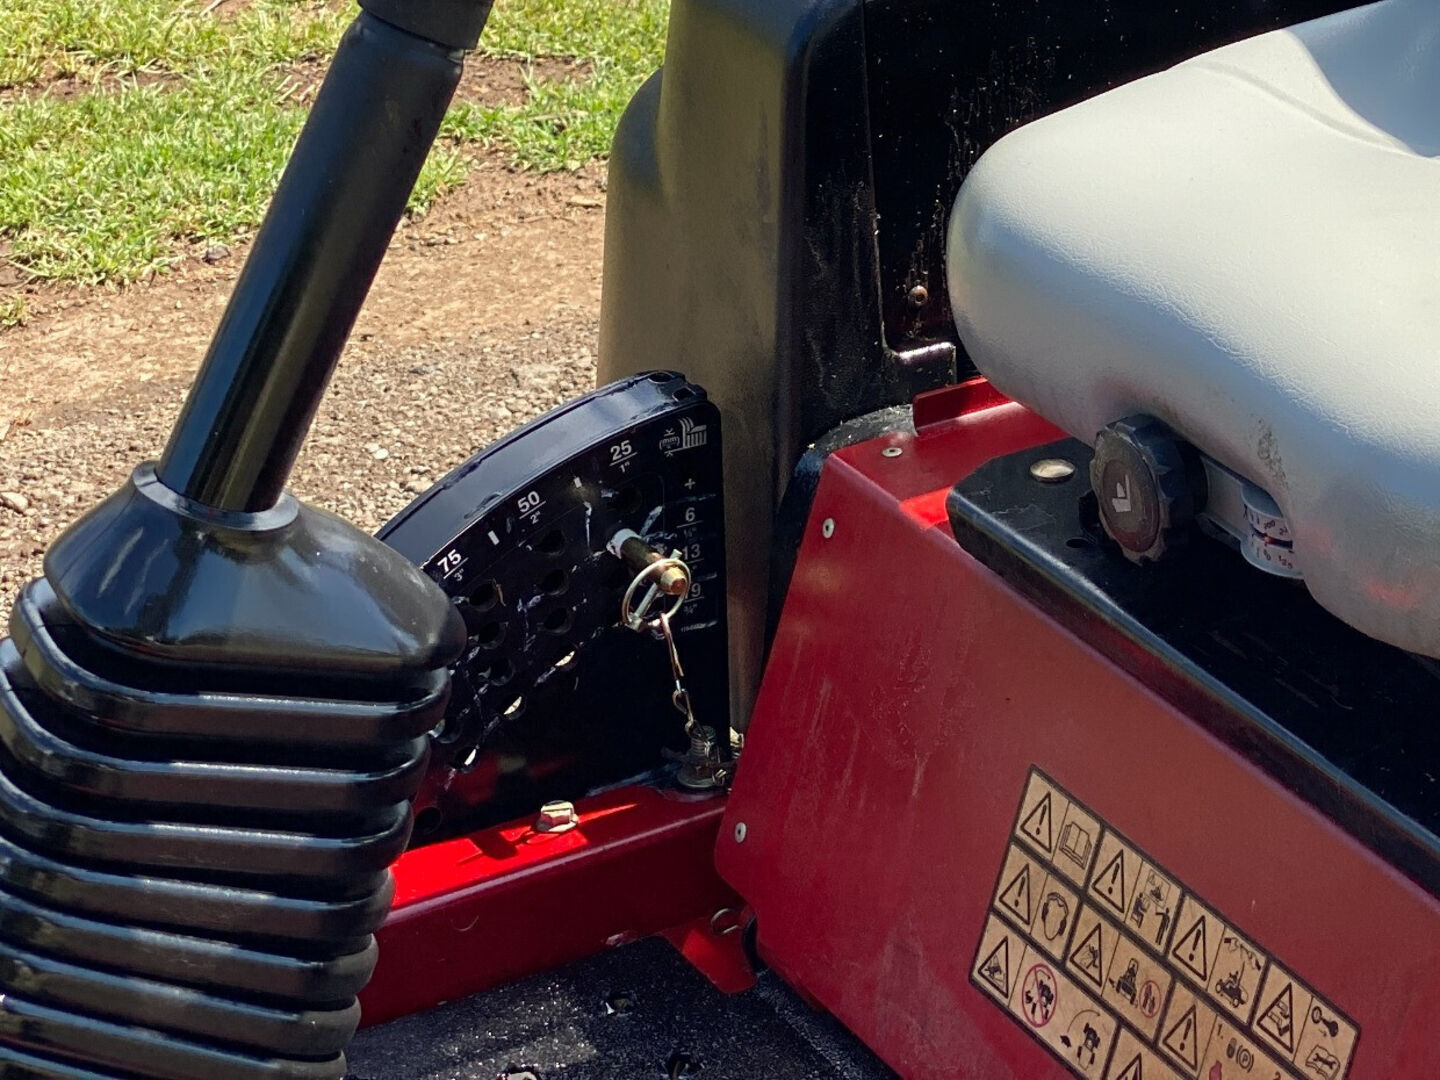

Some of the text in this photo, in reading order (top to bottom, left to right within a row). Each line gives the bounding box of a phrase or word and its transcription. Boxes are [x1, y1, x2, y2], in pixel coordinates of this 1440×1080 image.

[610, 439, 632, 461] 25
[517, 491, 541, 513] 50
[685, 506, 696, 522] 6
[437, 548, 462, 573] 75
[682, 542, 701, 561] 13
